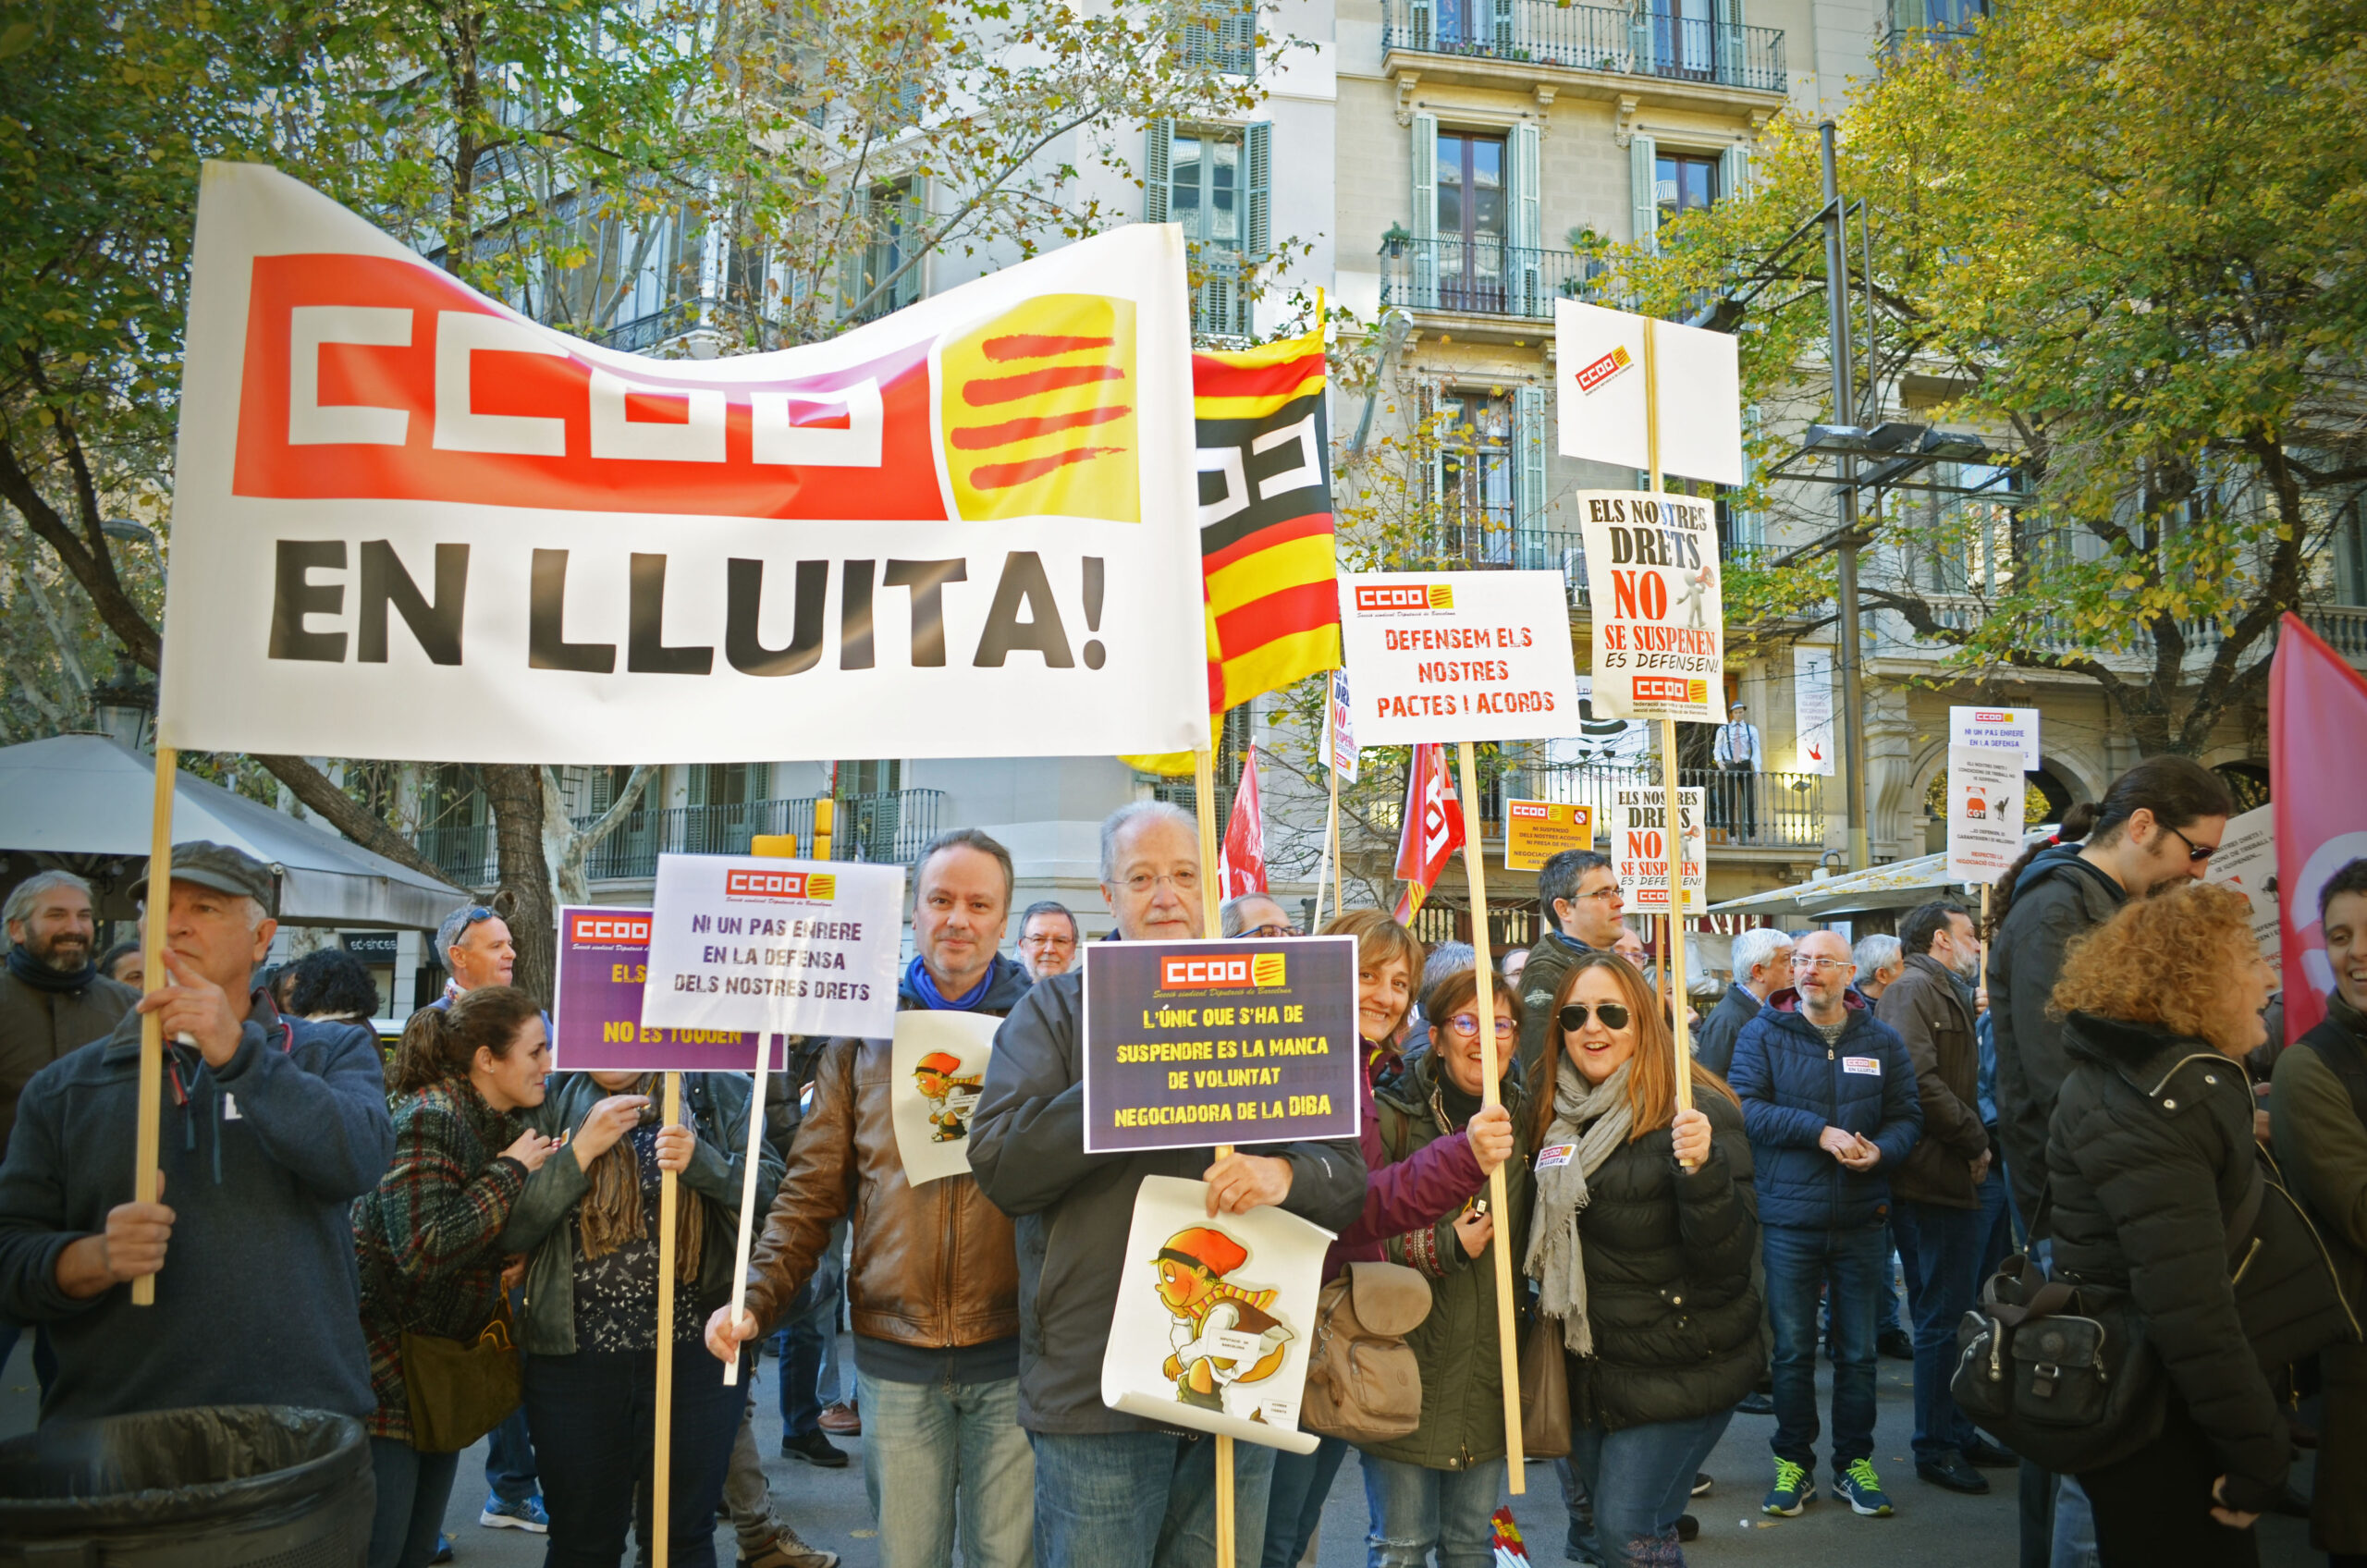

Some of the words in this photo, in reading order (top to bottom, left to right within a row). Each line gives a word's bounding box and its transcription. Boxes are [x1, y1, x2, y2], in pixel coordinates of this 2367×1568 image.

[1578, 357, 1615, 387] CCOO
[288, 304, 883, 468] CCOO
[1588, 499, 1625, 523] ELS
[1630, 500, 1708, 532] NOSTRES
[1609, 527, 1701, 570] DRETS
[1359, 589, 1424, 606] CCOO
[1611, 570, 1667, 620] NO
[268, 538, 471, 667] EN
[527, 549, 1107, 678] LLUITA!
[1385, 628, 1490, 651] DEFENSEM
[1498, 627, 1533, 648] ELS
[1604, 624, 1627, 651] SE
[1633, 625, 1716, 655] SUSPENEN
[1418, 659, 1509, 683] NOSTRES
[1605, 652, 1627, 668] ES
[1636, 653, 1719, 674] DEFENSEN!
[1637, 680, 1685, 698] CCOO
[1378, 694, 1457, 718] PACTES
[1477, 690, 1555, 715] ACORDS
[1976, 714, 2002, 722] CCOO
[1965, 728, 1973, 736] NI
[2000, 729, 2025, 738] ENRERE
[1991, 740, 2020, 748] DEFENSA
[1618, 790, 1638, 805] ELS
[1643, 790, 1698, 806] NOSRES
[1513, 805, 1546, 817] CCOO
[1628, 807, 1691, 828] DRES
[1967, 808, 1986, 818] CGT
[1627, 830, 1662, 859] NO
[1621, 861, 1635, 876] SE
[1638, 861, 1699, 876] SUSPEN
[730, 874, 801, 893] CCOO
[1621, 876, 1635, 886] ES
[1639, 876, 1702, 887] DEFEEN!
[1639, 891, 1669, 900] CCO
[576, 921, 648, 939] CCOO
[692, 913, 711, 934] NI
[717, 916, 742, 936] UN
[749, 918, 786, 937] PAS
[792, 920, 862, 941] ENRERE
[703, 945, 727, 964] EN
[733, 947, 758, 965] LA
[765, 948, 846, 970] DEFENSA
[611, 963, 647, 984] ELS
[1167, 961, 1246, 983] CCOO
[674, 974, 719, 993] DELS
[725, 976, 808, 998] NOSTRES
[815, 981, 870, 1001] DRETS
[1202, 1008, 1235, 1028] QUE
[1283, 1004, 1304, 1023] DE
[604, 1021, 634, 1044] NO
[640, 1028, 663, 1044] ES
[1116, 1041, 1213, 1063] SUSPENDRE
[1217, 1040, 1237, 1060] ES
[1242, 1039, 1266, 1059] LA
[1269, 1036, 1330, 1057] MANCA
[1168, 1071, 1189, 1090] DE
[1193, 1067, 1282, 1089] VOLUNTAT
[1114, 1103, 1233, 1128] NEGOCIADORA
[1237, 1101, 1257, 1121] DE
[1261, 1100, 1285, 1120] LA
[1289, 1094, 1331, 1117] DIBA
